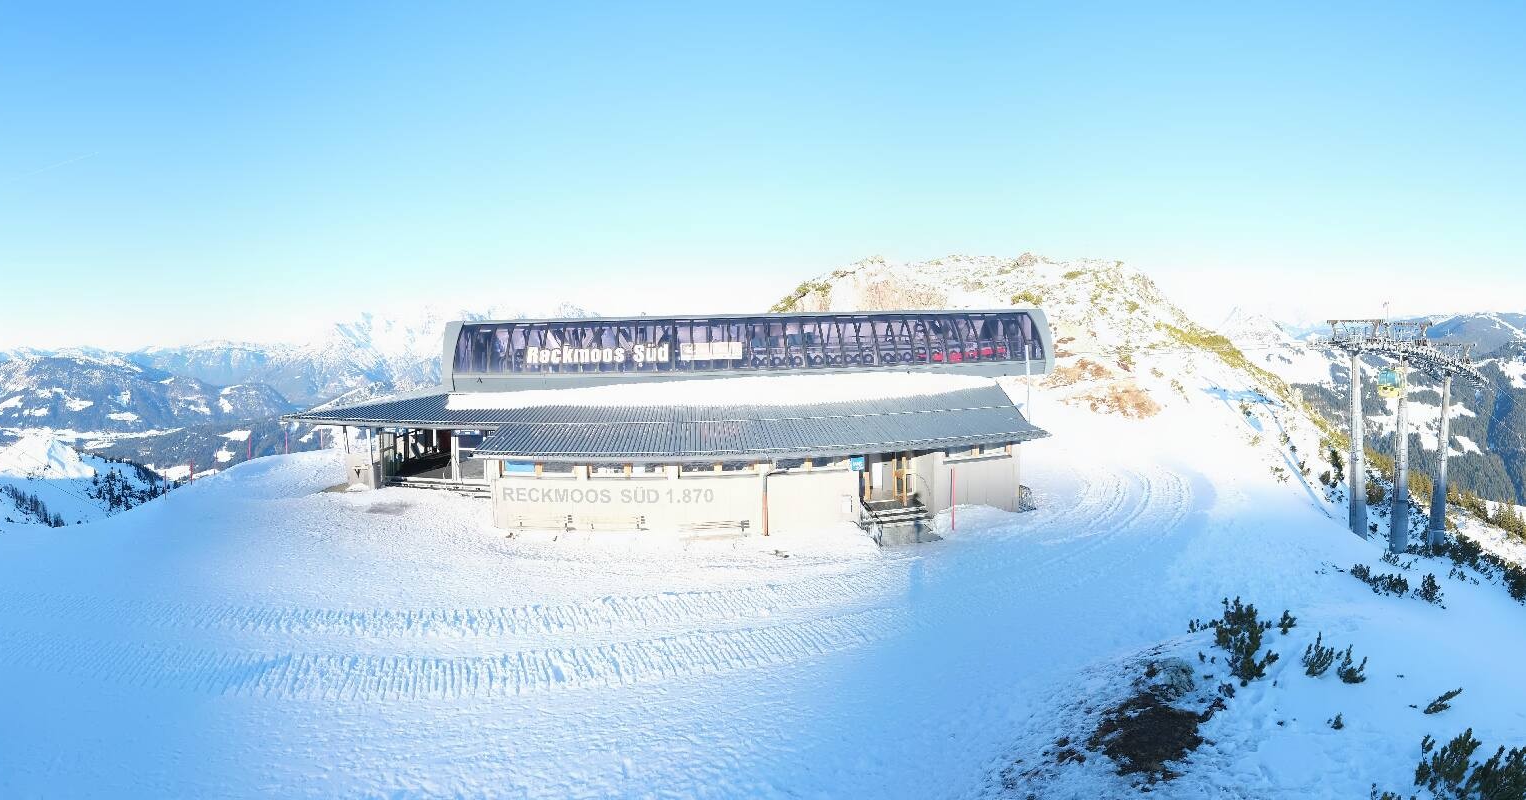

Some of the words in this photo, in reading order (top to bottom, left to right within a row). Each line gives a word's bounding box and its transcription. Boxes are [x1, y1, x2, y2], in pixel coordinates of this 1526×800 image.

[526, 344, 625, 364] Reckmoos
[633, 343, 669, 363] Süd
[502, 487, 612, 503] RECKMOOS
[620, 486, 660, 504] SÜD
[666, 488, 715, 504] 1.870
